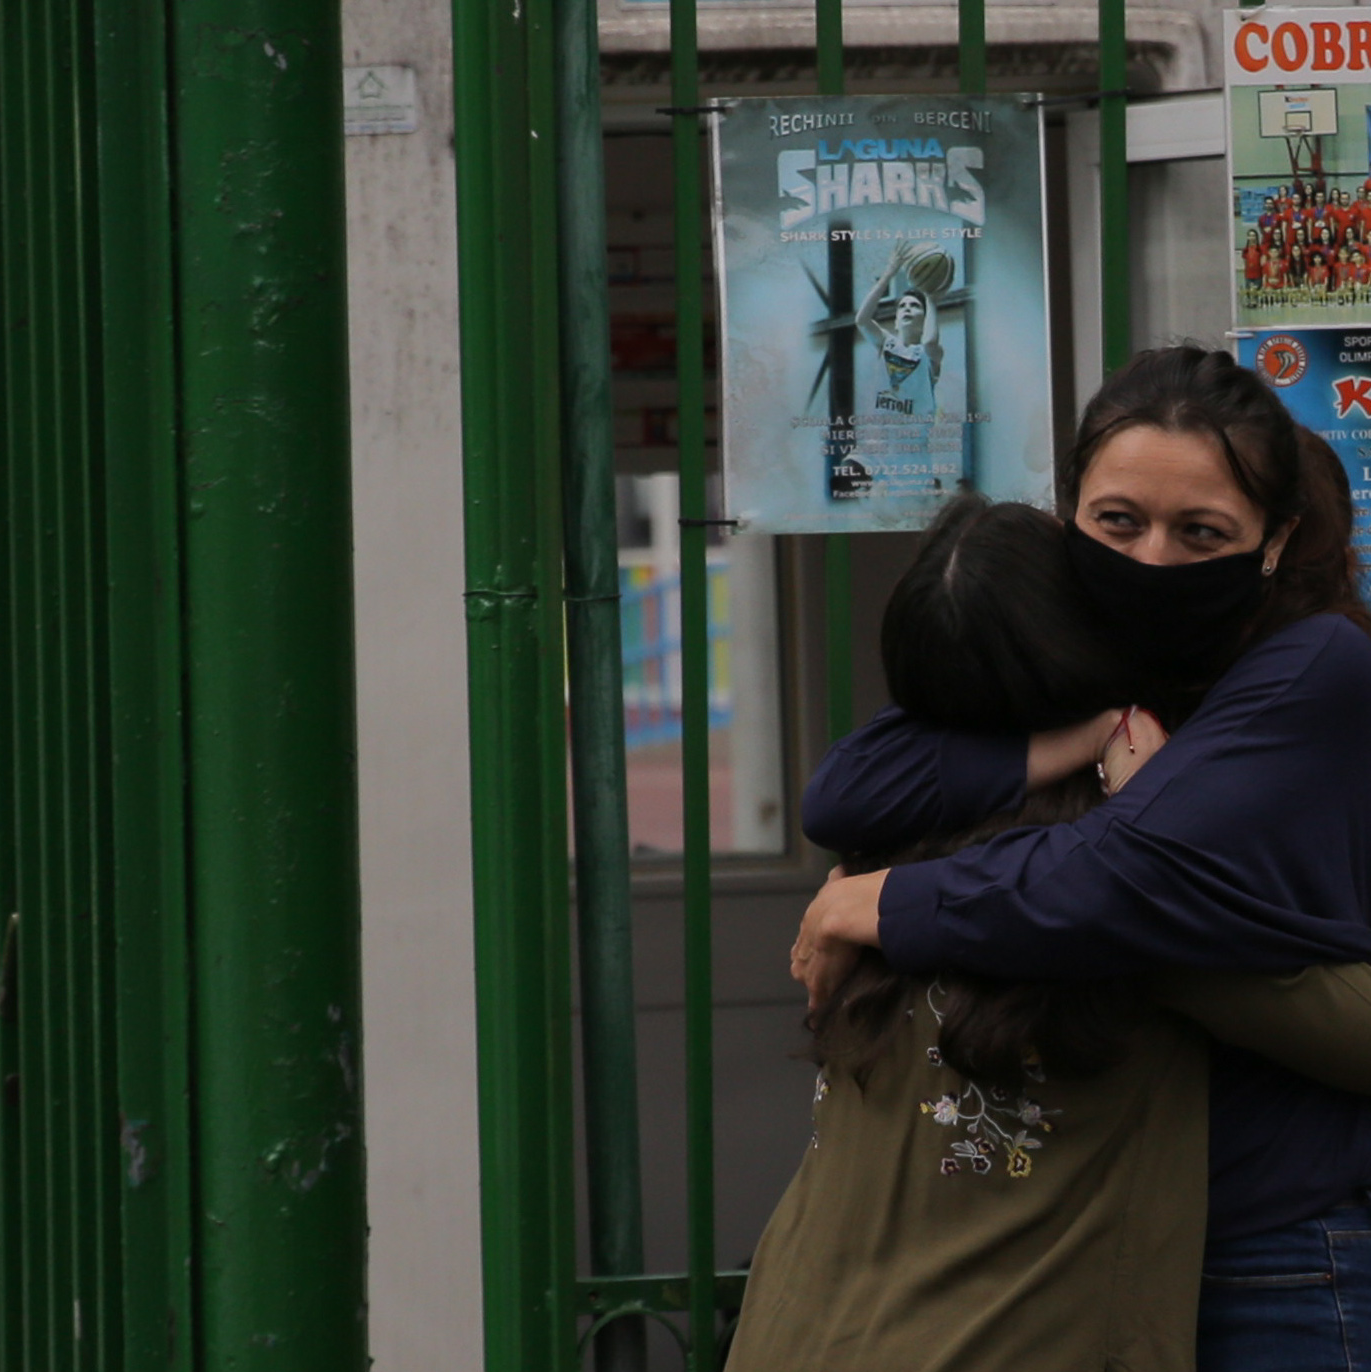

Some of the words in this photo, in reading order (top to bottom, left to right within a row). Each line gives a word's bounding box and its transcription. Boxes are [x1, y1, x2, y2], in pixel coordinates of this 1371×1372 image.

[769, 112, 855, 138] RECHINII
[914, 111, 992, 134] BERCENI
[818, 138, 944, 161] LAGUNA
[777, 146, 987, 231] SHARKS
[780, 230, 827, 243] SHARK
[830, 229, 872, 241] STYLE
[894, 230, 904, 240] A
[907, 229, 937, 240] LIFE
[941, 227, 983, 239] STYLE
[833, 466, 861, 477] TEL.
